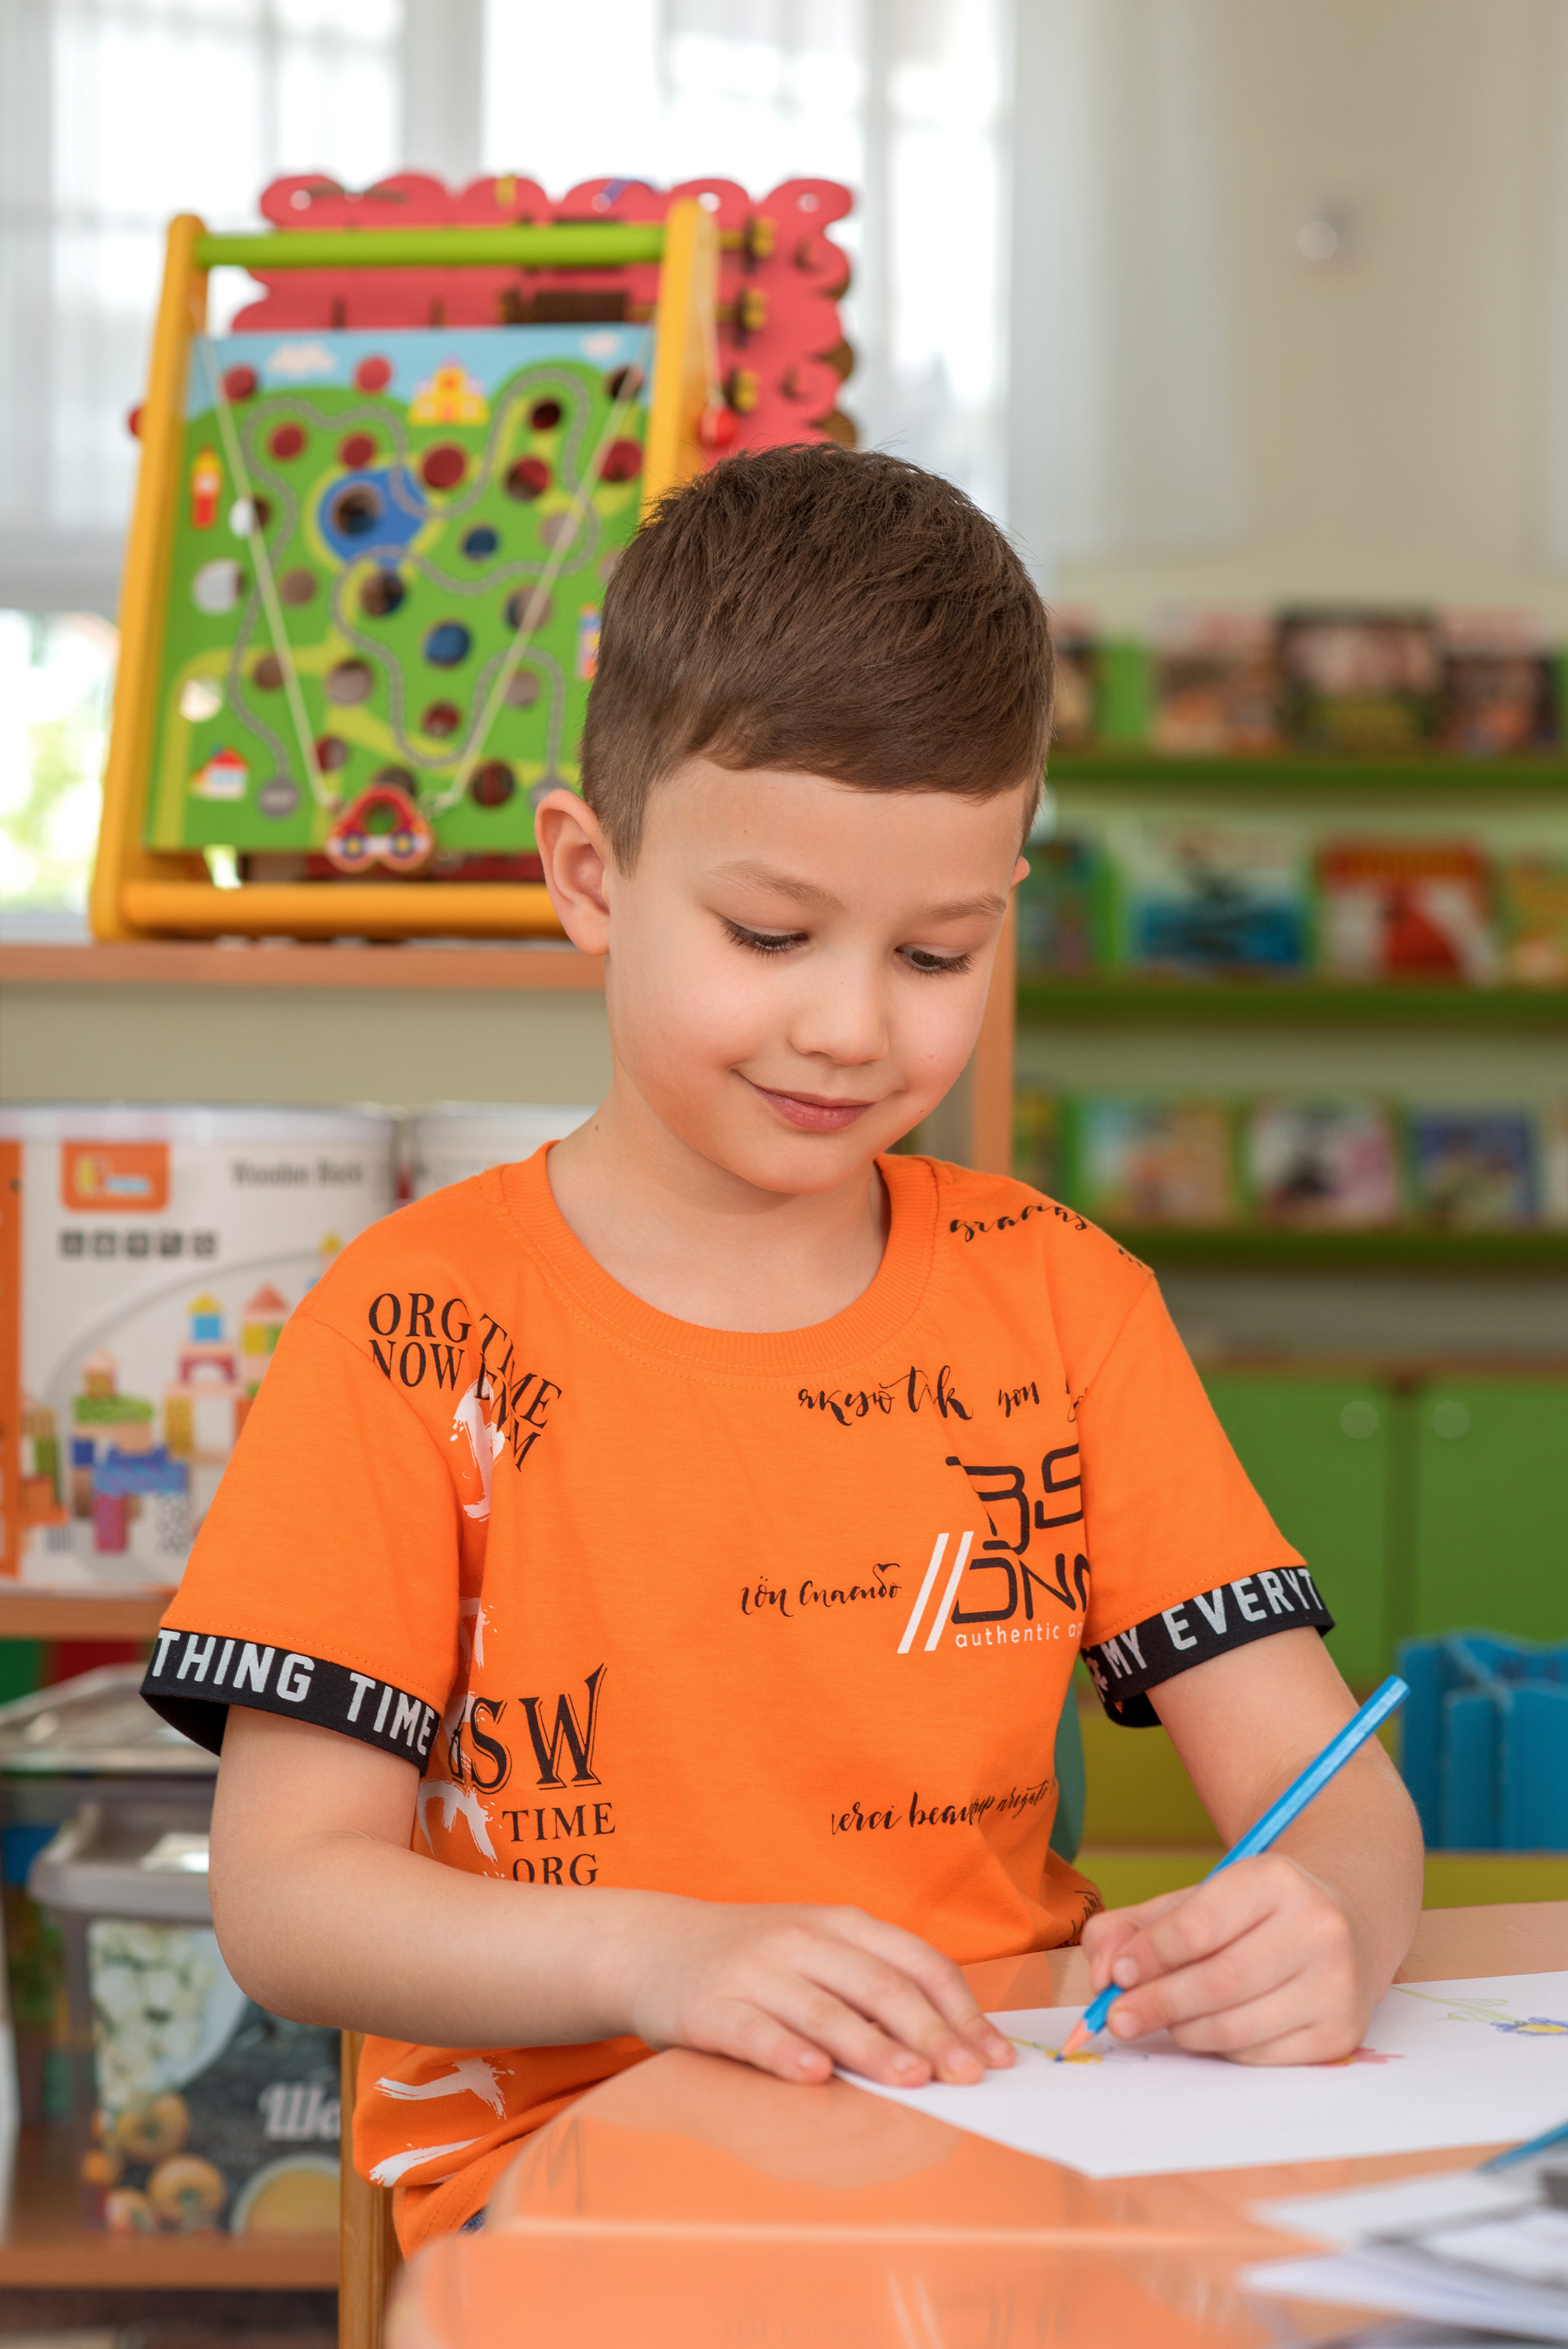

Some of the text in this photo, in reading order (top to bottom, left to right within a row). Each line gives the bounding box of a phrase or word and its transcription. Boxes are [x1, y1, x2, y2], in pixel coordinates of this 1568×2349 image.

[369, 1293, 563, 1429] ORG TIME
[369, 1339, 466, 1391] NOW
[956, 1622, 1060, 1647] authentic
[1100, 1625, 1148, 1679] MY
[152, 1630, 435, 1757] THING TIME
[502, 1802, 616, 1842] TIME
[513, 1853, 599, 1886] ORG
